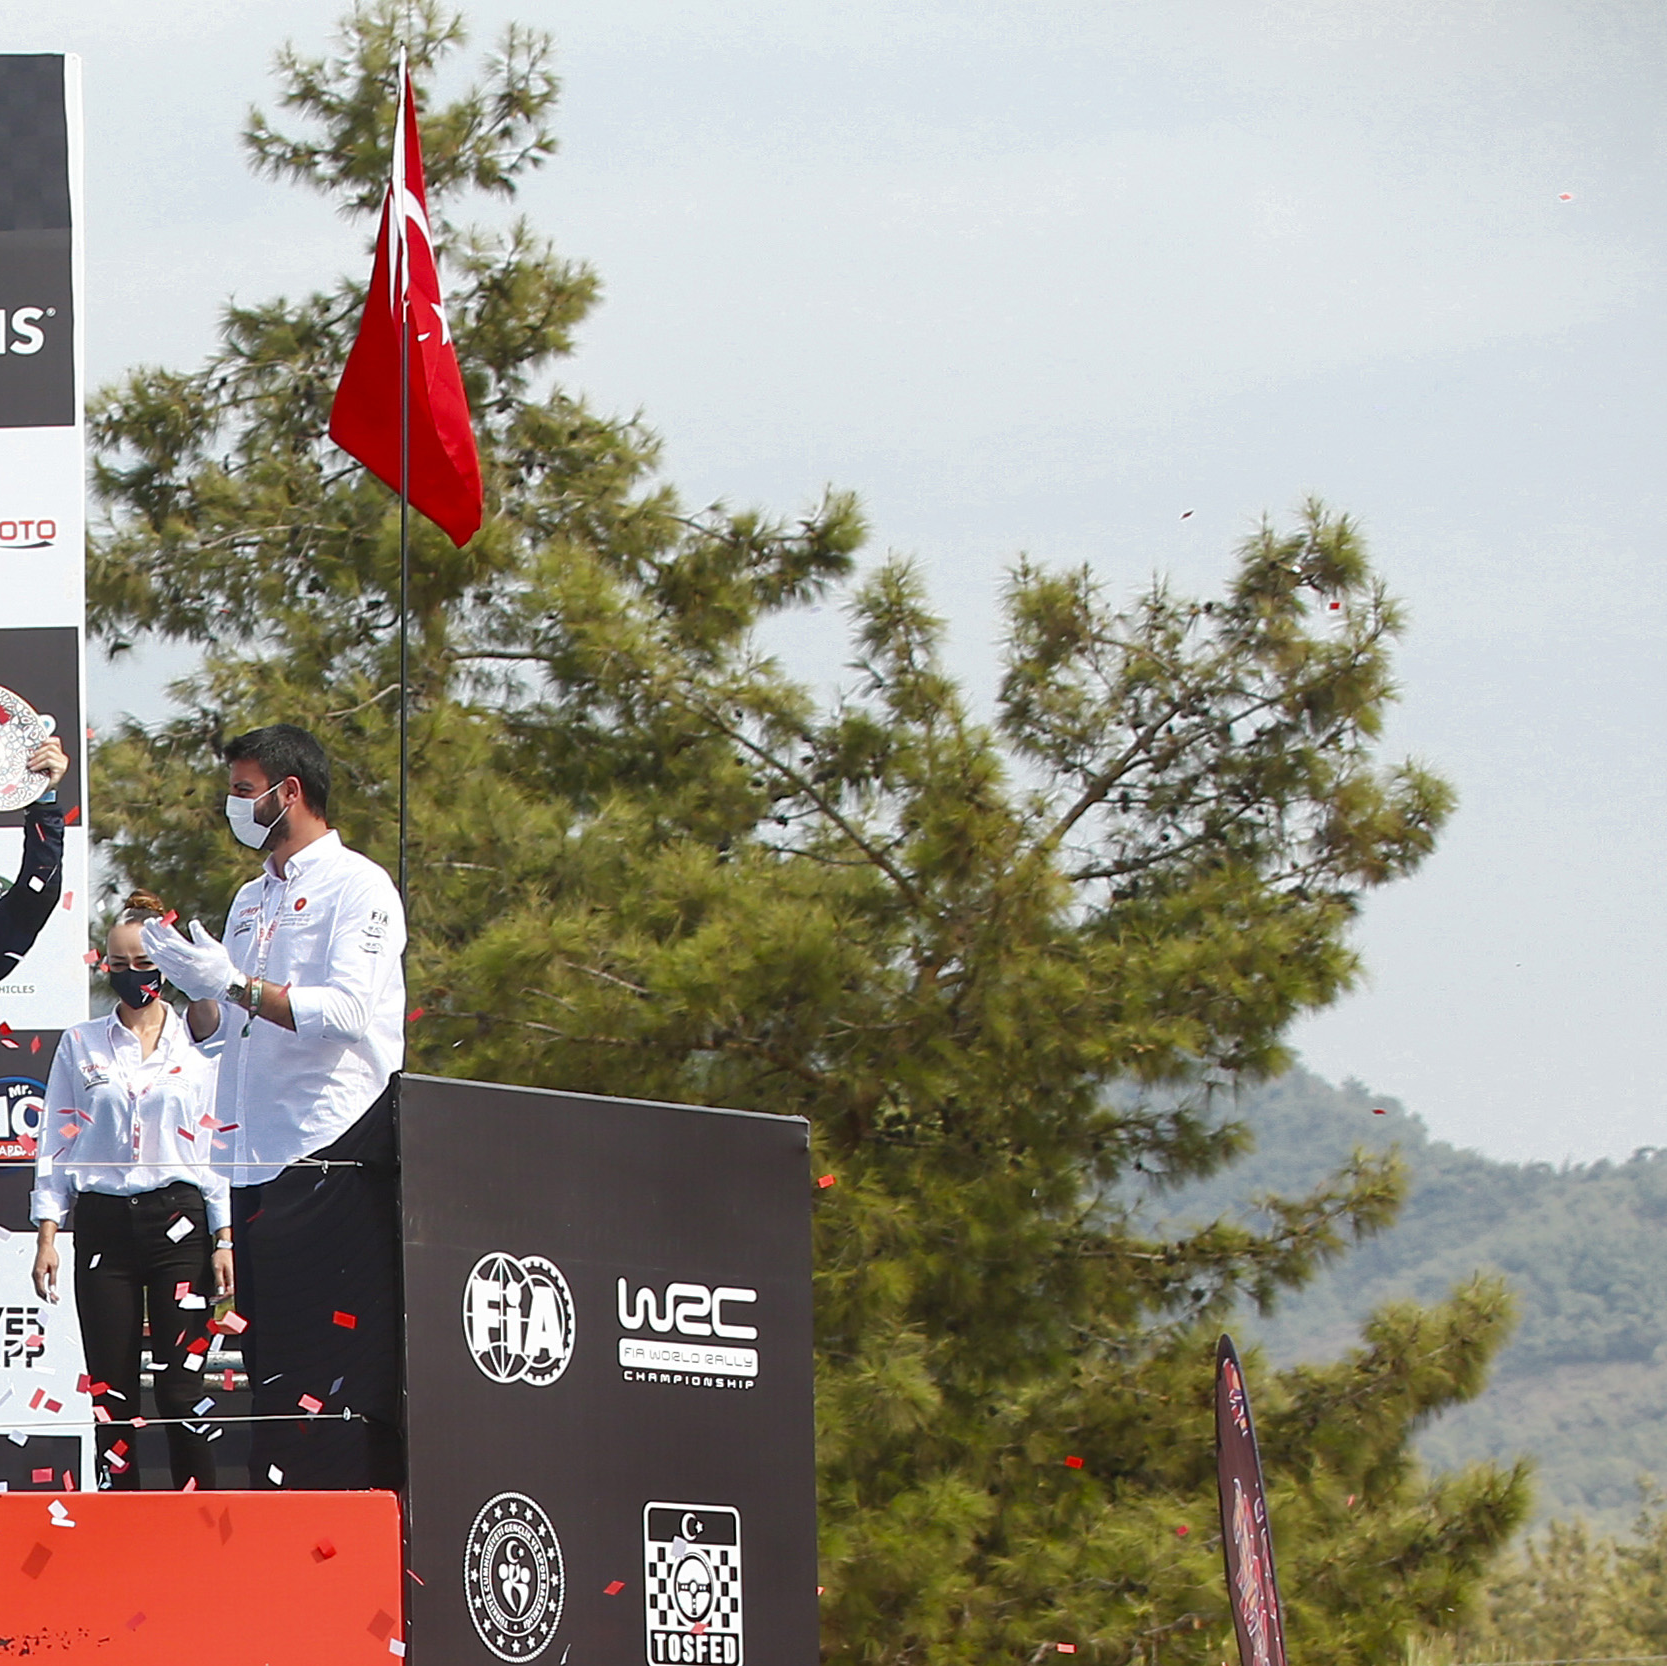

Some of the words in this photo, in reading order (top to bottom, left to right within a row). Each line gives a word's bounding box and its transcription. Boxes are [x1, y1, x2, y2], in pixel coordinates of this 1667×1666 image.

[8, 1084, 32, 1099] Mr.
[616, 1276, 758, 1340] WRC
[623, 1346, 646, 1359] FIA
[649, 1349, 701, 1364] WORLD
[705, 1353, 754, 1369] RALLY
[623, 1369, 755, 1390] CHAMPIONSHIP
[653, 1633, 738, 1666] TOSFED
